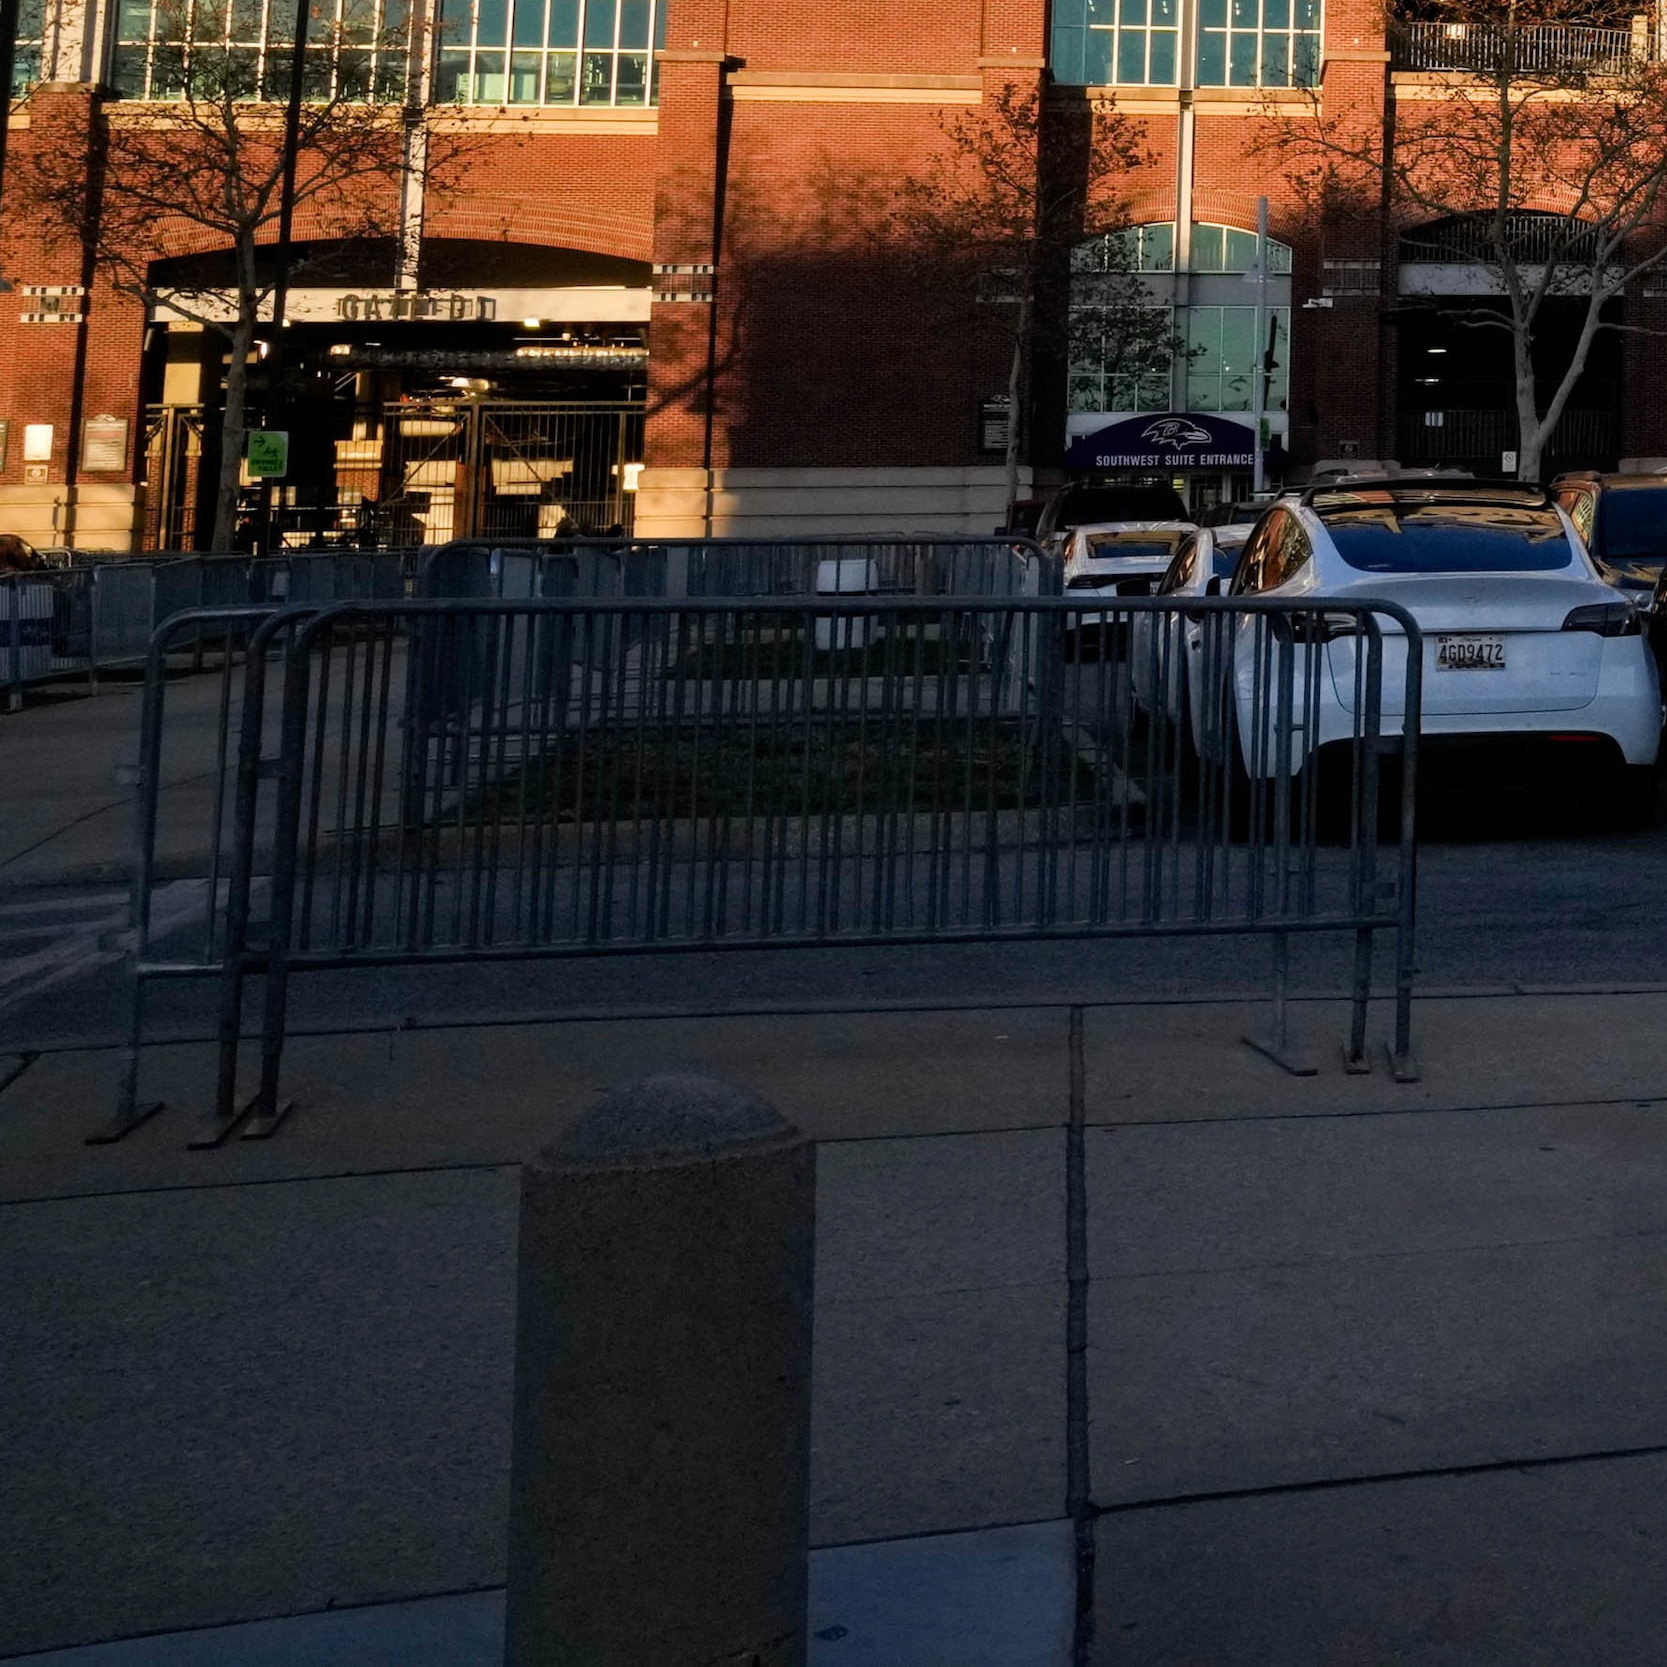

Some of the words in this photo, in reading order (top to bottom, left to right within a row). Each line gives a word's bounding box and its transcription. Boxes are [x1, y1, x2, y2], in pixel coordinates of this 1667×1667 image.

[1095, 454, 1160, 467] SOUTHWEST
[1165, 454, 1195, 466] SUITE
[1200, 453, 1254, 466] ENTRANCE
